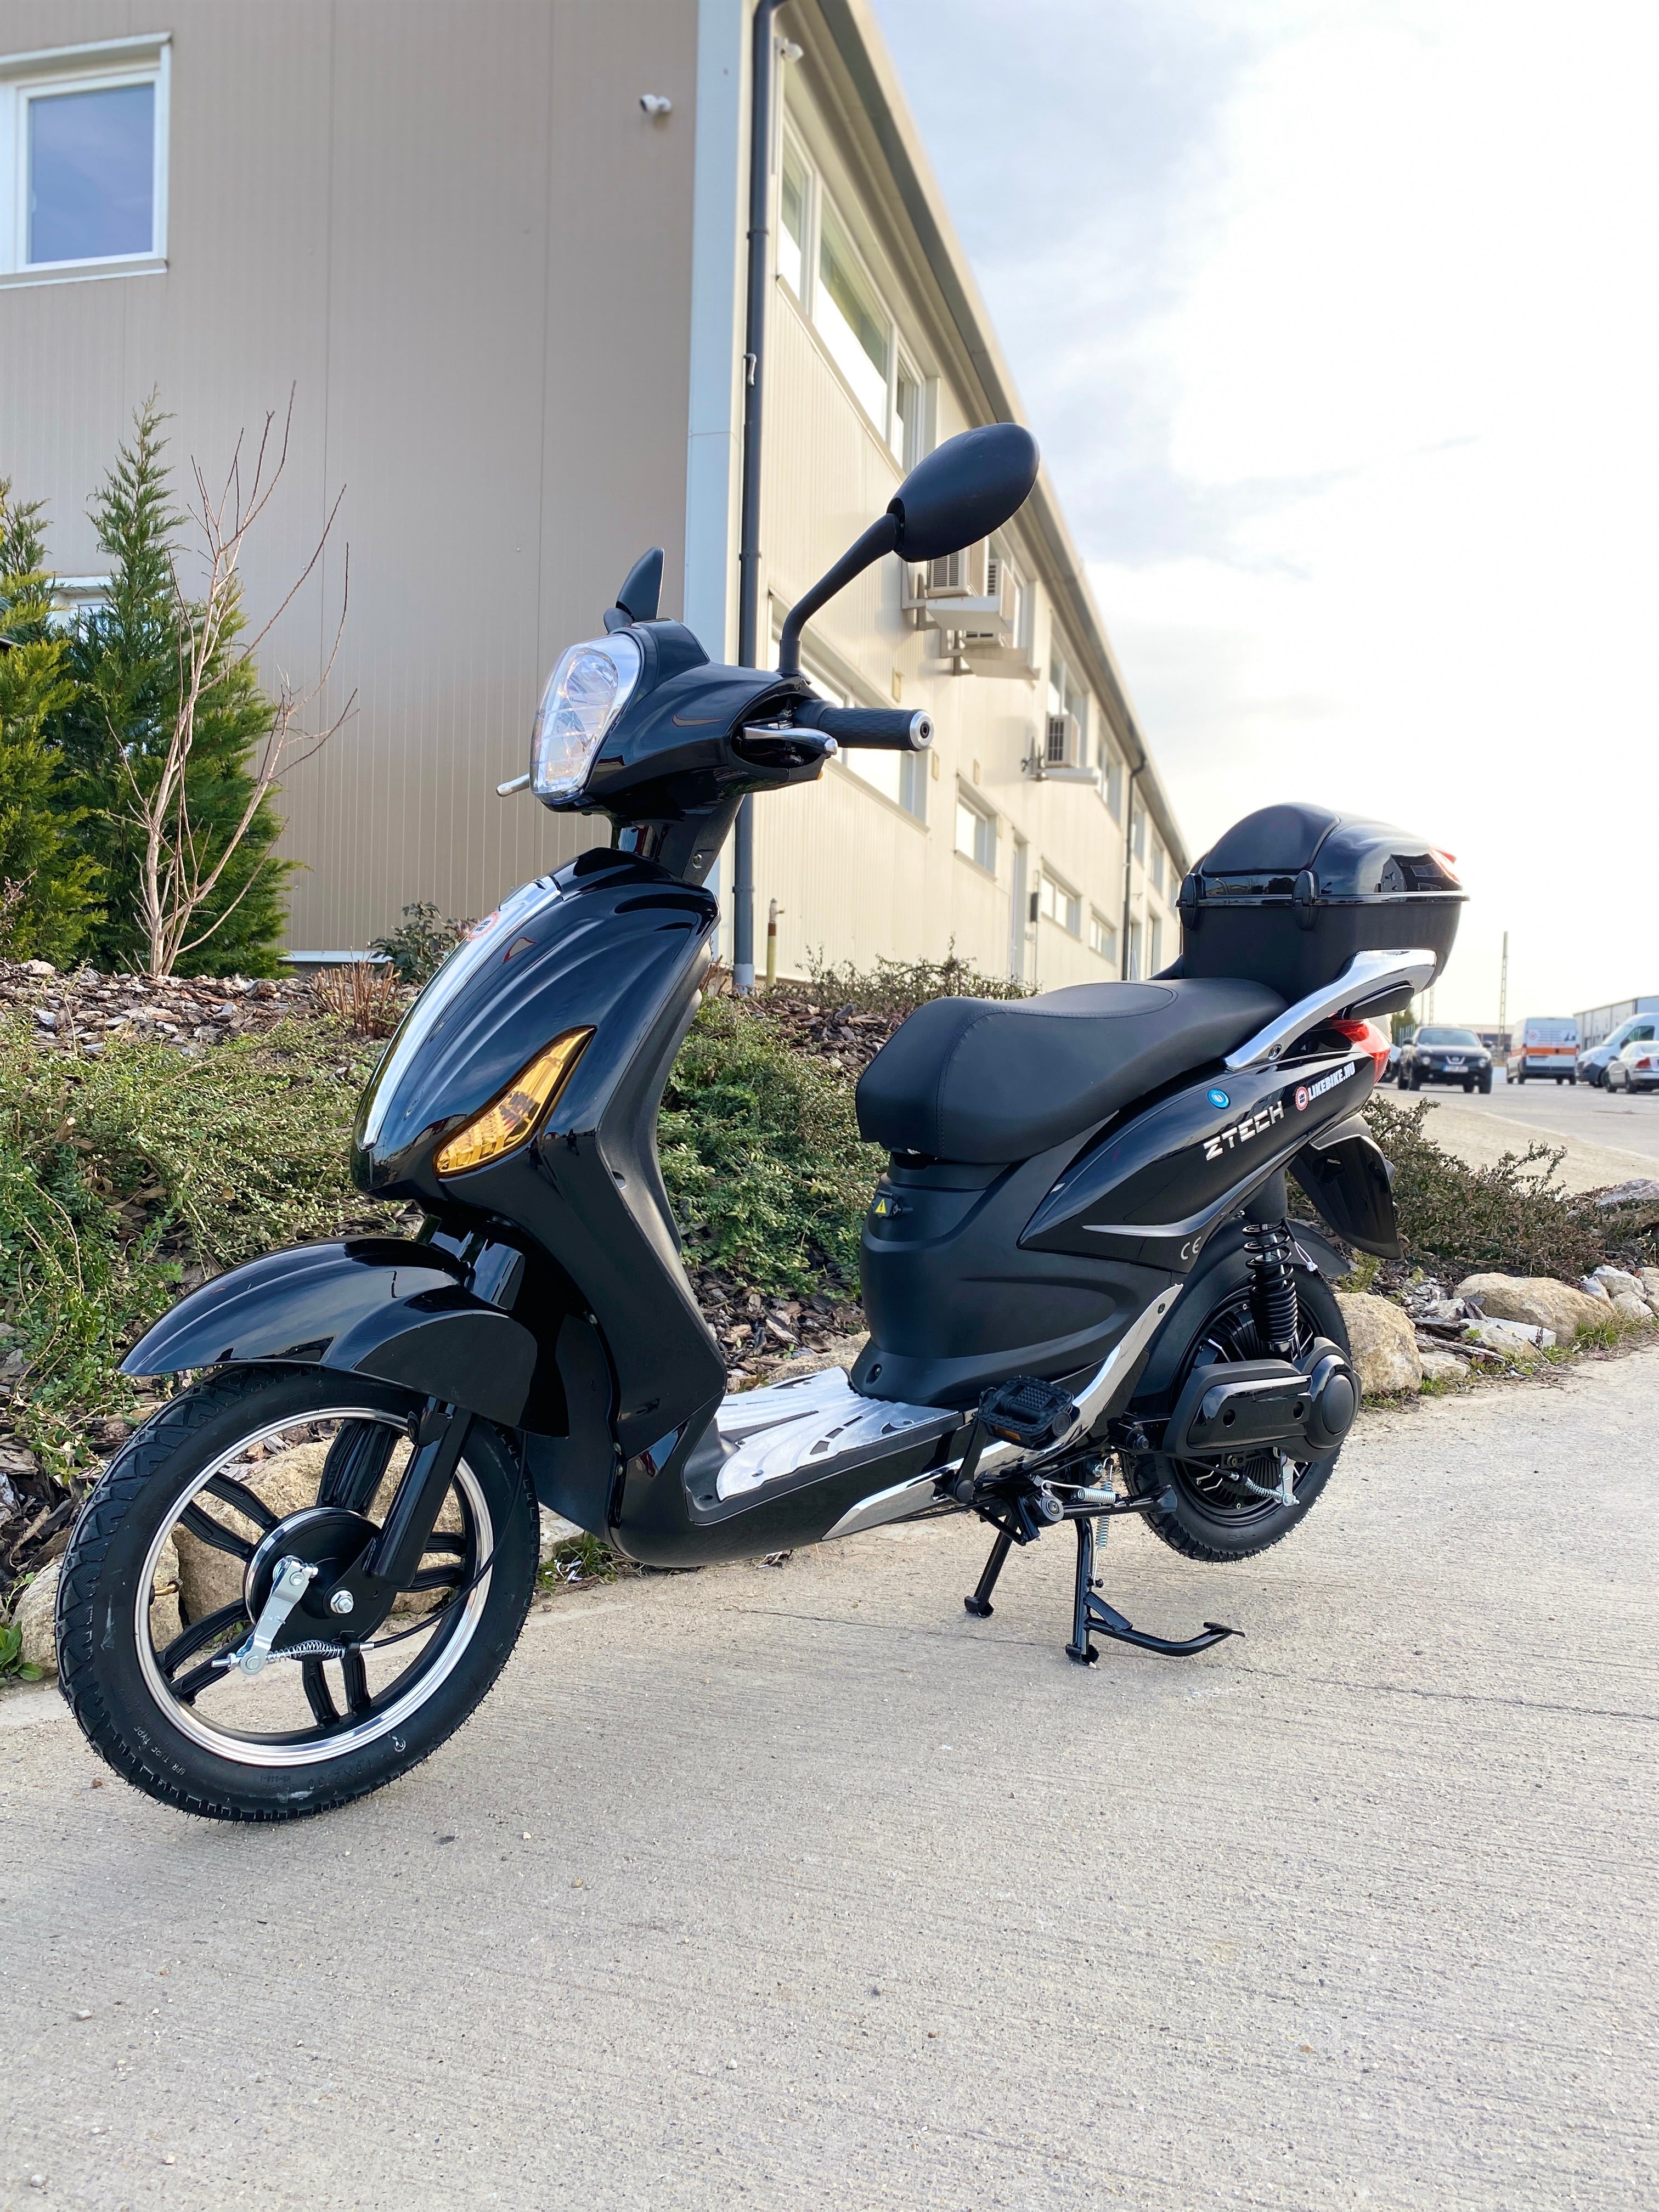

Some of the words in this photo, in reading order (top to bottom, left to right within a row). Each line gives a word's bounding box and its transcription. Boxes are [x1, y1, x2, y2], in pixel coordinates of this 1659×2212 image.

[1308, 1062, 1355, 1101] LIKEBIKE.HU
[1203, 1101, 1285, 1161] ZTECH
[1181, 1235, 1202, 1260] CE
[134, 1726, 151, 1745] TYPE
